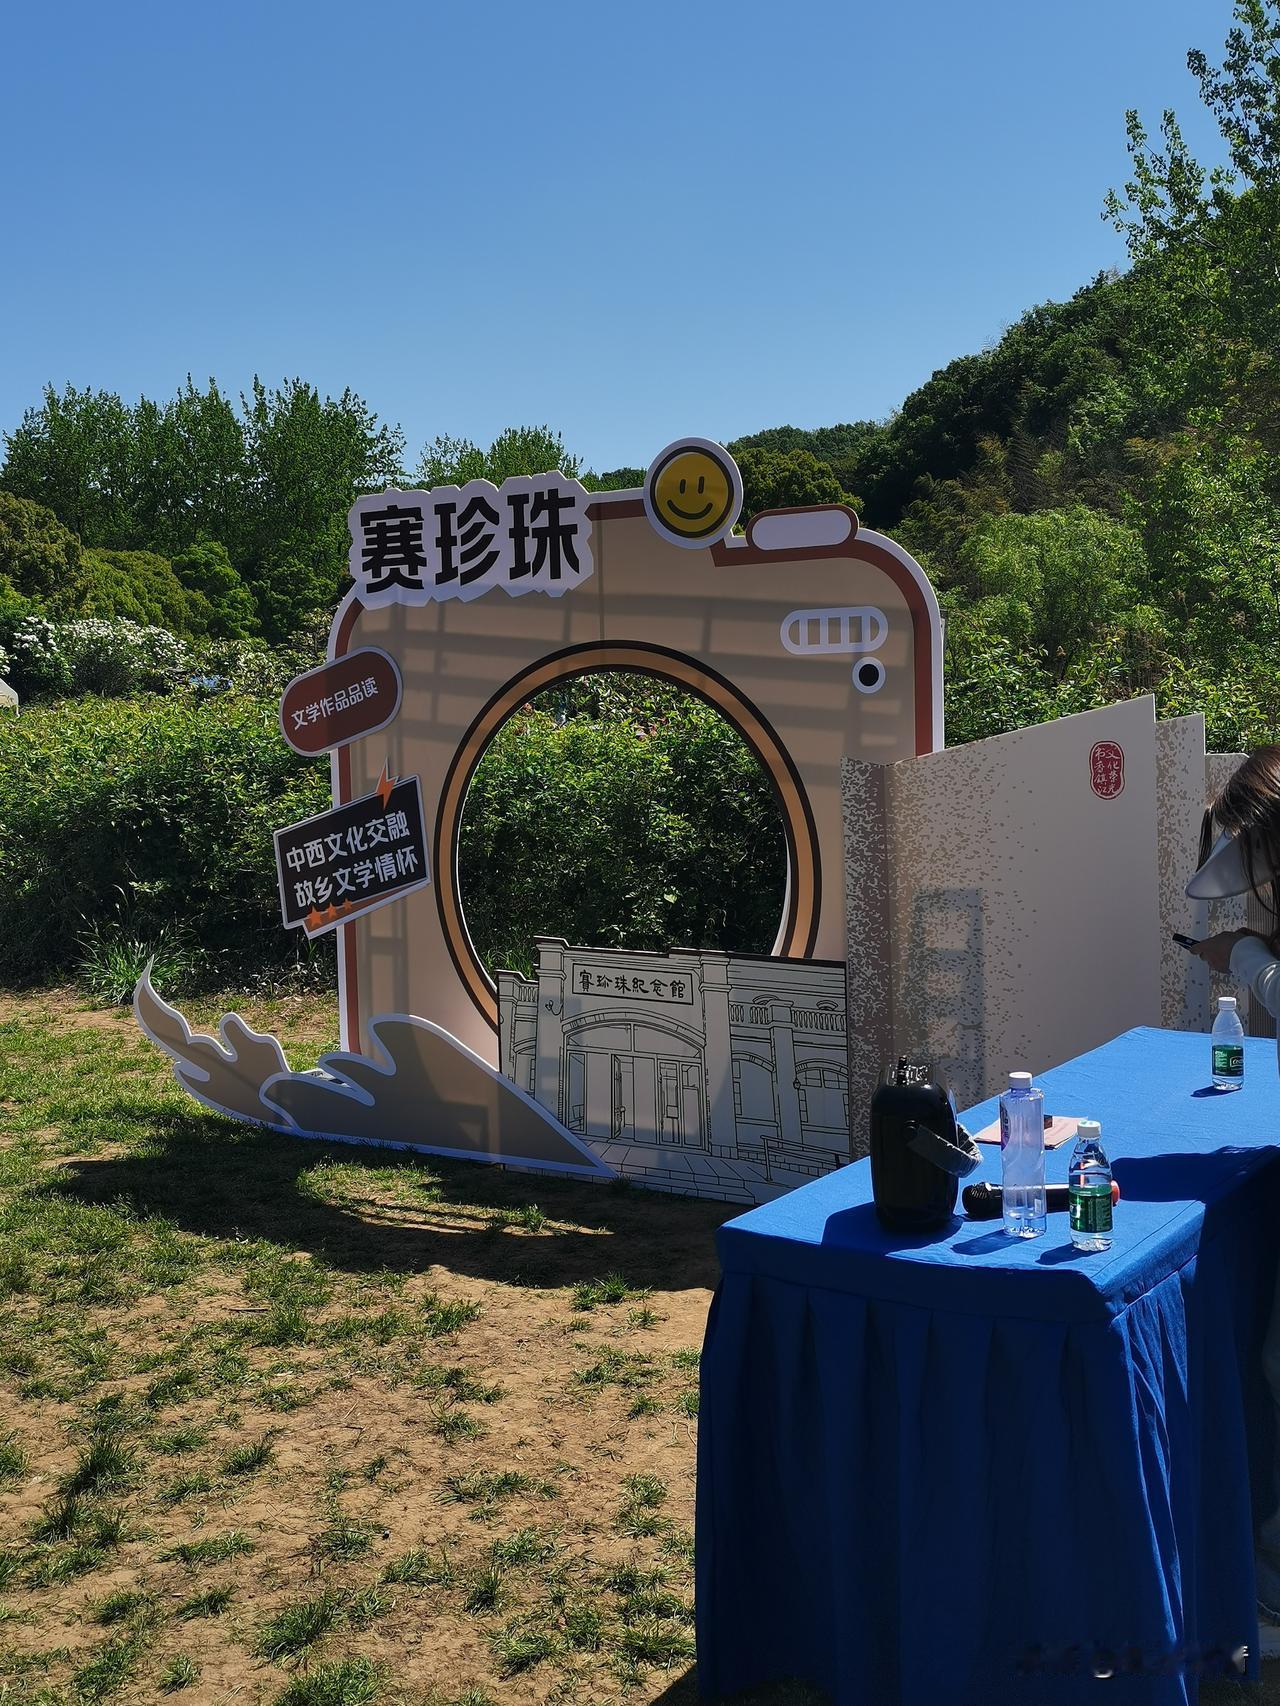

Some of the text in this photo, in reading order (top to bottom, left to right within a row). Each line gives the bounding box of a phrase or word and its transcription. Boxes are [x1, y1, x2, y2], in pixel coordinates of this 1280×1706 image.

[359, 488, 580, 592] 赛珍珠
[290, 676, 378, 731] 文学作品品读
[285, 810, 408, 875] 中西文化交融
[294, 845, 419, 908] 故乡文学情怀
